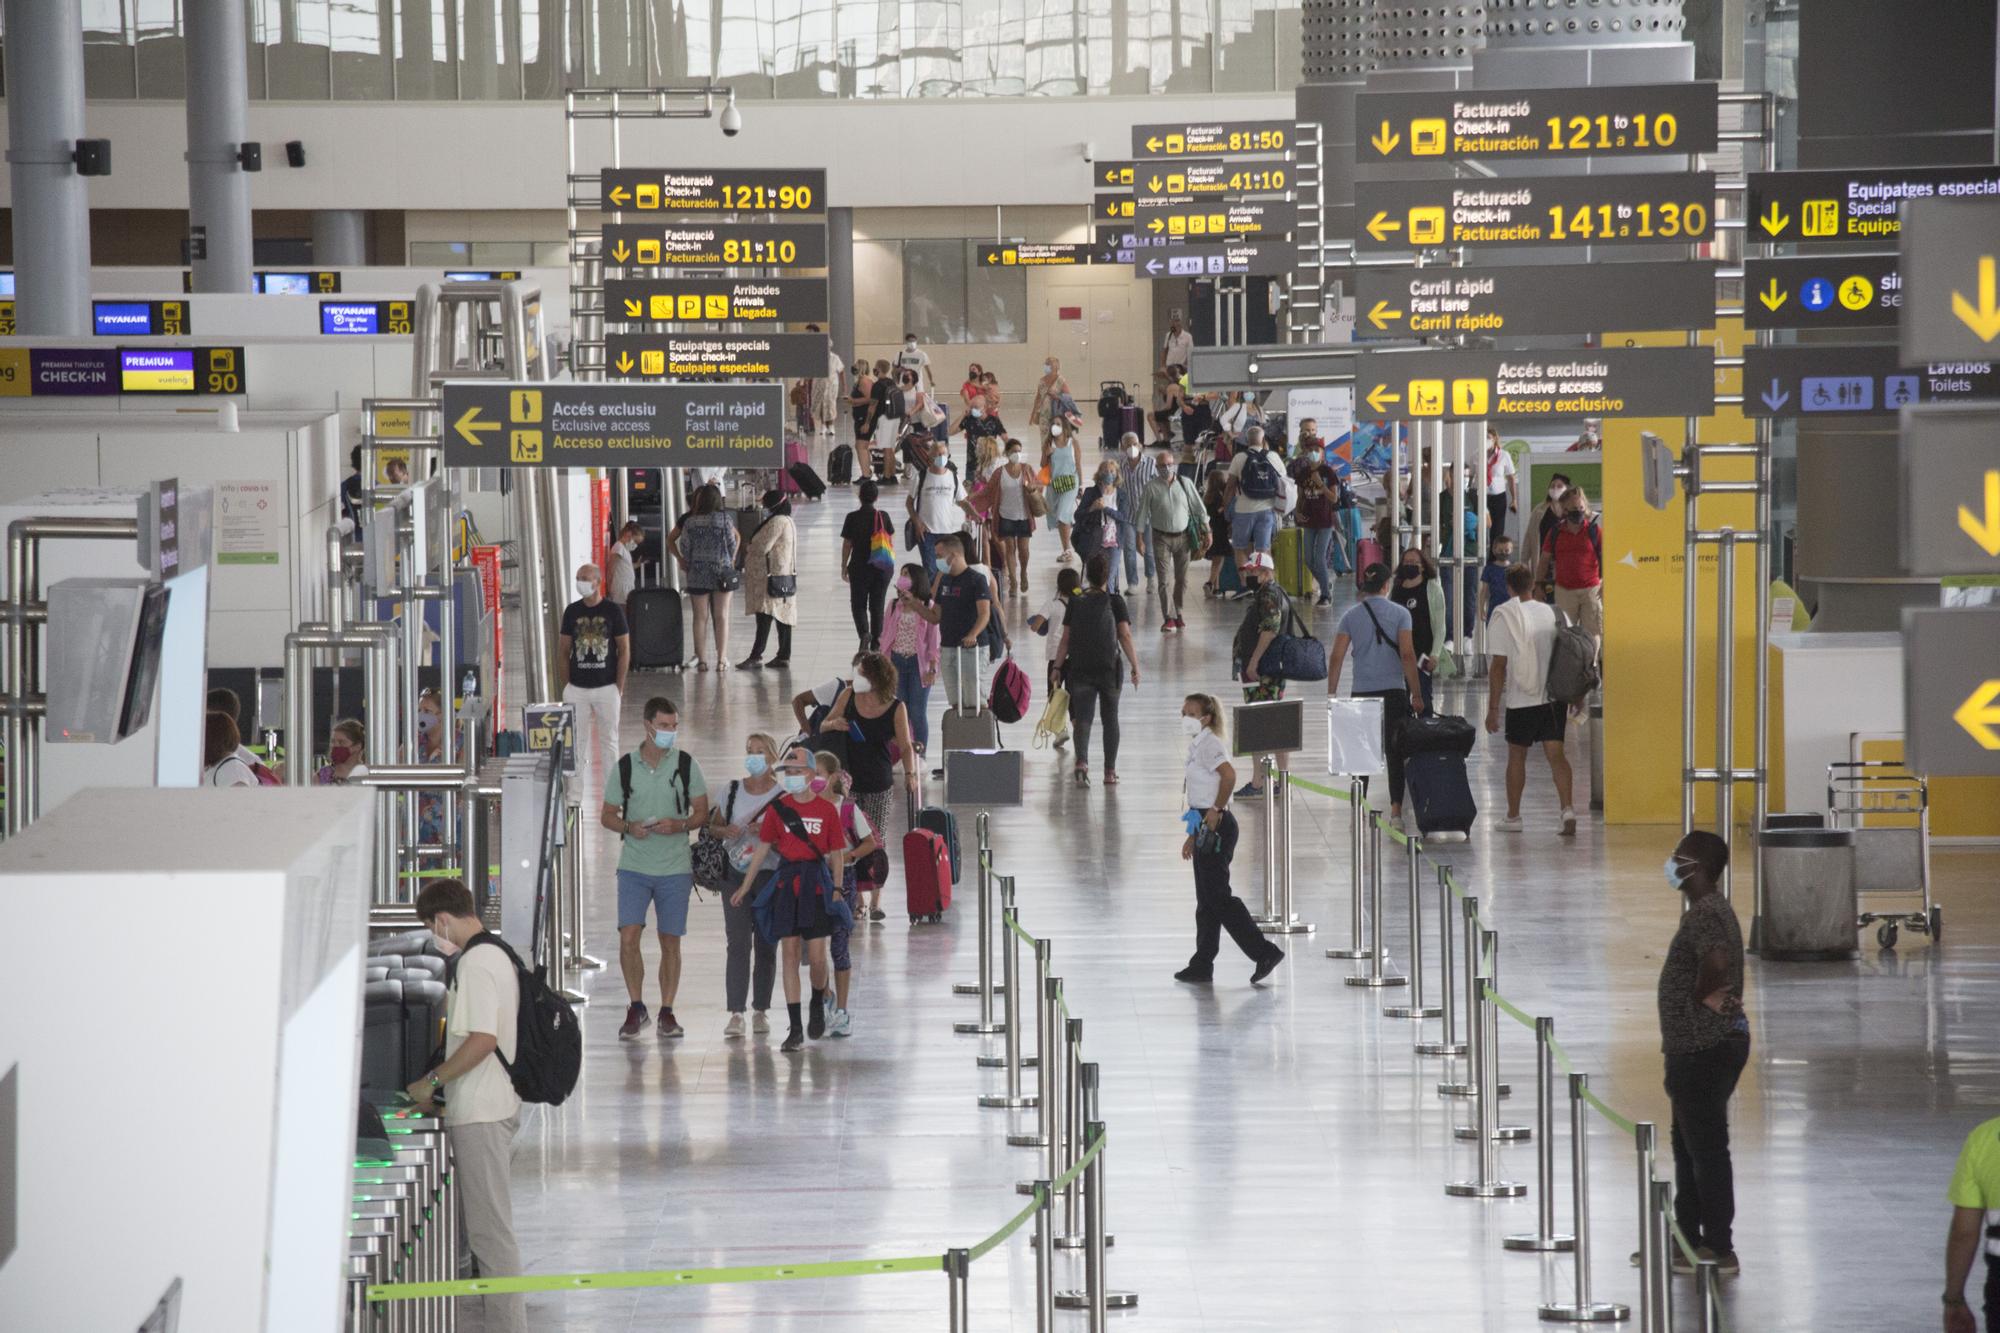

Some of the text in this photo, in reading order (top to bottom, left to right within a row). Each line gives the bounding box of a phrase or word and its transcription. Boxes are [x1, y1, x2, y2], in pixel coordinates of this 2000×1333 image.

[1454, 101, 1530, 117] Facturació
[1454, 120, 1510, 134] Check-in
[1548, 114, 1677, 150] 121 to 10
[1230, 132, 1252, 150] 81
[1260, 130, 1284, 148] 50
[1454, 136, 1539, 152] Facturación
[1616, 136, 1626, 146] a
[664, 174, 714, 187] Facturació
[1230, 172, 1252, 190] 41
[1262, 171, 1284, 189] 10
[664, 187, 700, 196] Check-in
[722, 185, 812, 209] 121 to 90
[1848, 182, 1933, 199] Equipatges
[664, 197, 719, 209] Facturación
[1453, 190, 1531, 206] Facturació
[1848, 202, 1896, 216] Special
[1453, 210, 1510, 223] Check-in
[1548, 202, 1706, 239] 141 to 130
[665, 229, 714, 241] Facturació
[1453, 224, 1540, 241] Facturación
[1620, 224, 1629, 237] a
[666, 242, 702, 250] Check-in
[723, 239, 796, 263] 81 to 10
[666, 252, 720, 263] Facturación
[734, 285, 780, 295] Arribades
[1410, 278, 1494, 296] Carril ràpid
[734, 297, 764, 306] Arrivals
[1410, 299, 1469, 312] Fast lane
[330, 307, 376, 315] RYANAIR
[734, 307, 777, 319] Llegadas
[164, 321, 182, 335] 51
[388, 322, 410, 334] 50
[1410, 315, 1503, 333] Carril rápido
[669, 340, 770, 353] Equipatges especials
[126, 357, 174, 366] PREMIUM
[669, 352, 736, 362] Special check-in
[669, 362, 769, 375] Equipajes especiales
[1498, 362, 1608, 378] Accés exclusiu
[40, 372, 106, 382] CHECK-IN
[158, 376, 188, 384] vueling
[208, 374, 238, 392] 90
[1497, 381, 1603, 394] Exclusive access
[1929, 380, 1972, 392] Toilets
[553, 402, 765, 419] Accés exclusiu Carril ràpid
[1498, 398, 1623, 413] Acceso exclusivo
[552, 420, 739, 431] Exclusive access Fast lane
[553, 435, 774, 451] Acceso exclusivo Carril rápido
